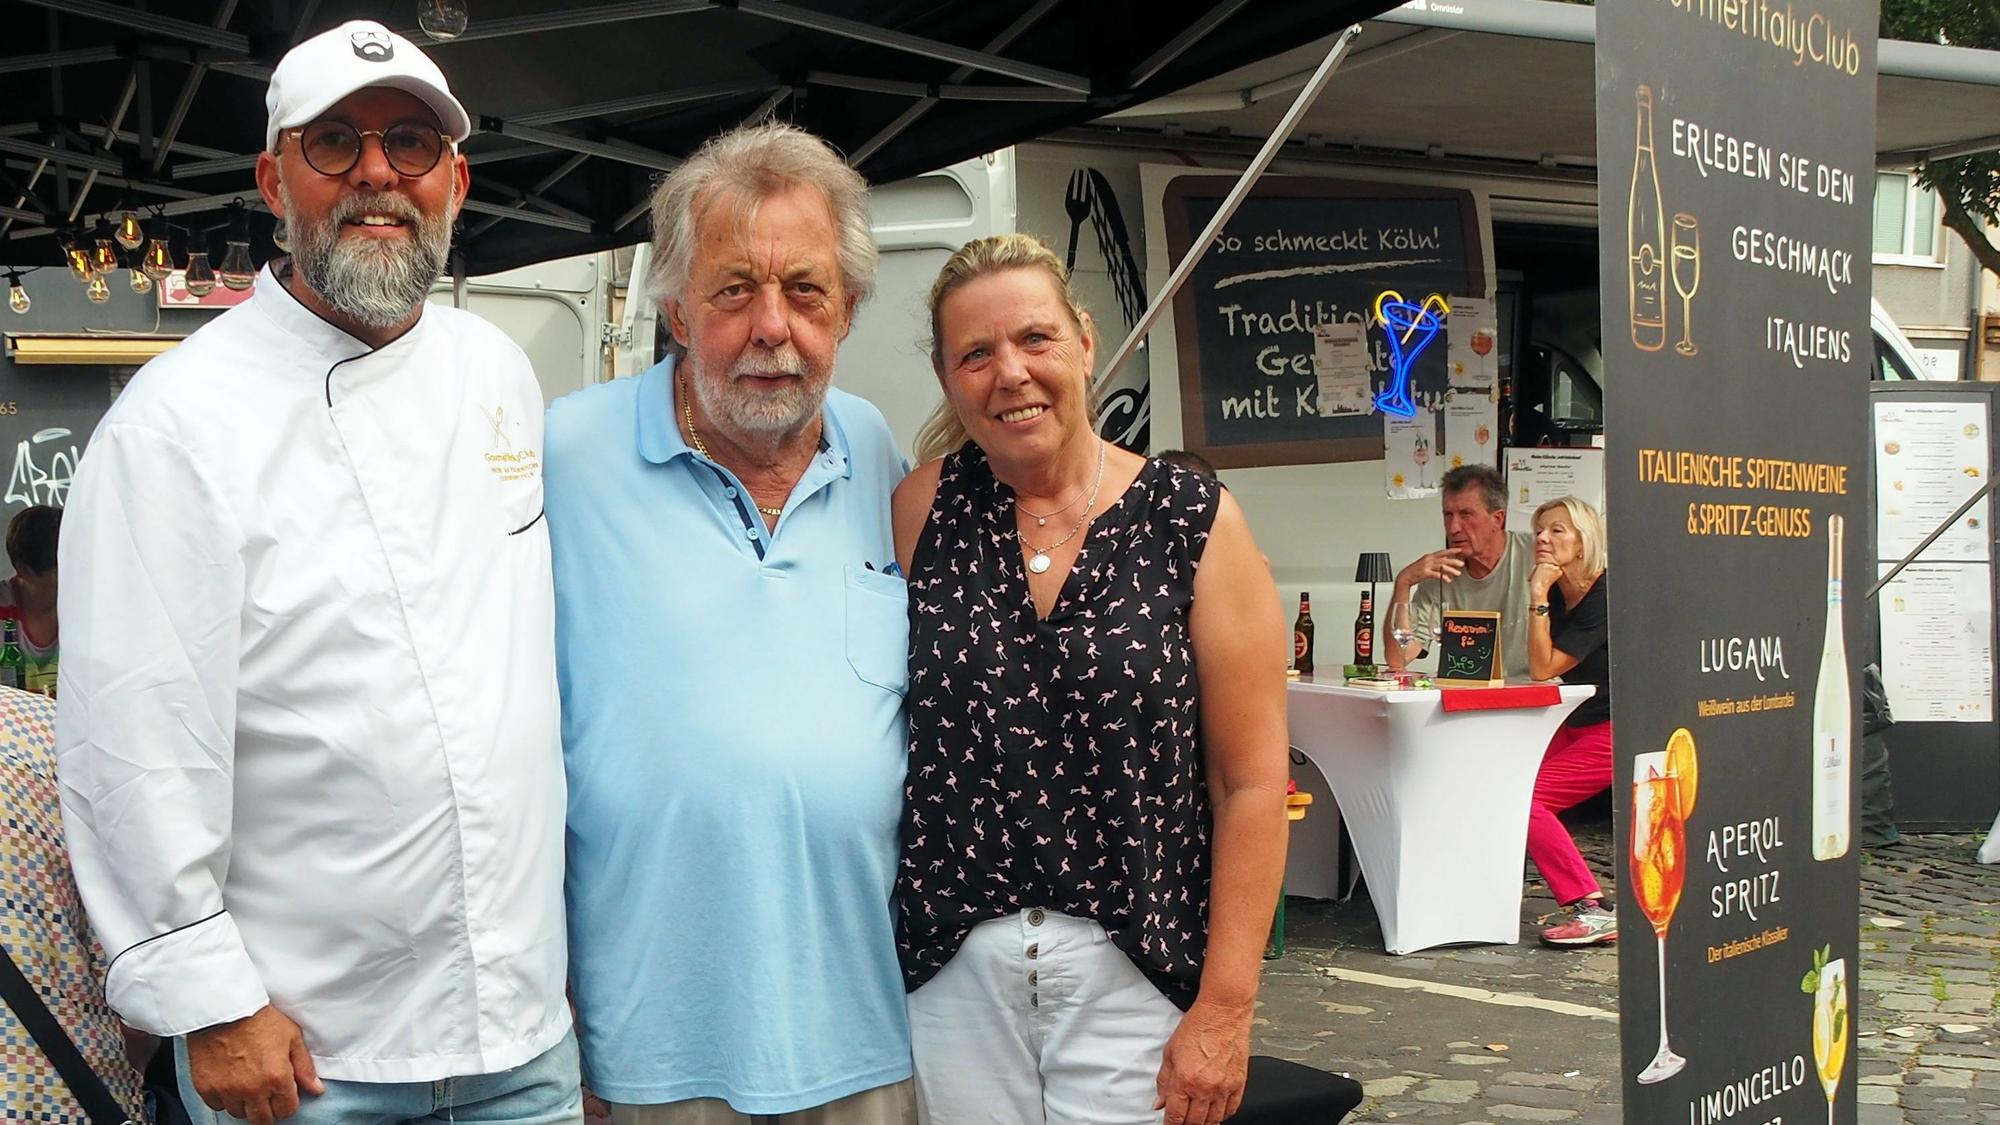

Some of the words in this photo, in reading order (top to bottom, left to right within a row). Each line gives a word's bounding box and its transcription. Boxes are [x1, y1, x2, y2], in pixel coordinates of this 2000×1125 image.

[1672, 118, 1770, 180] ERLEBEN
[1779, 153, 1810, 193] SIE
[1817, 164, 1854, 205] DEN
[1215, 230, 1242, 254] So
[1255, 227, 1369, 252] schmeckt
[1378, 226, 1440, 251] Köln!
[1732, 225, 1852, 295] GESCHMACK
[1767, 316, 1850, 369] ITALIENS
[1221, 385, 1281, 420] mit
[1639, 449, 1743, 489] ITALIENISCHE
[1746, 458, 1847, 495] SPITZENWEINE
[1687, 502, 1698, 535] &
[1699, 504, 1811, 537] SPRITZ-GENUSS
[1700, 636, 1790, 682] LUGANA
[1736, 700, 1750, 713] aus
[1751, 695, 1762, 711] der
[1706, 816, 1783, 873] APEROL
[1711, 870, 1780, 922] SPRITZ
[1708, 946, 1722, 963] Der
[1723, 934, 1761, 959] italienische
[1689, 1055, 1805, 1125] LIMONCELLO
